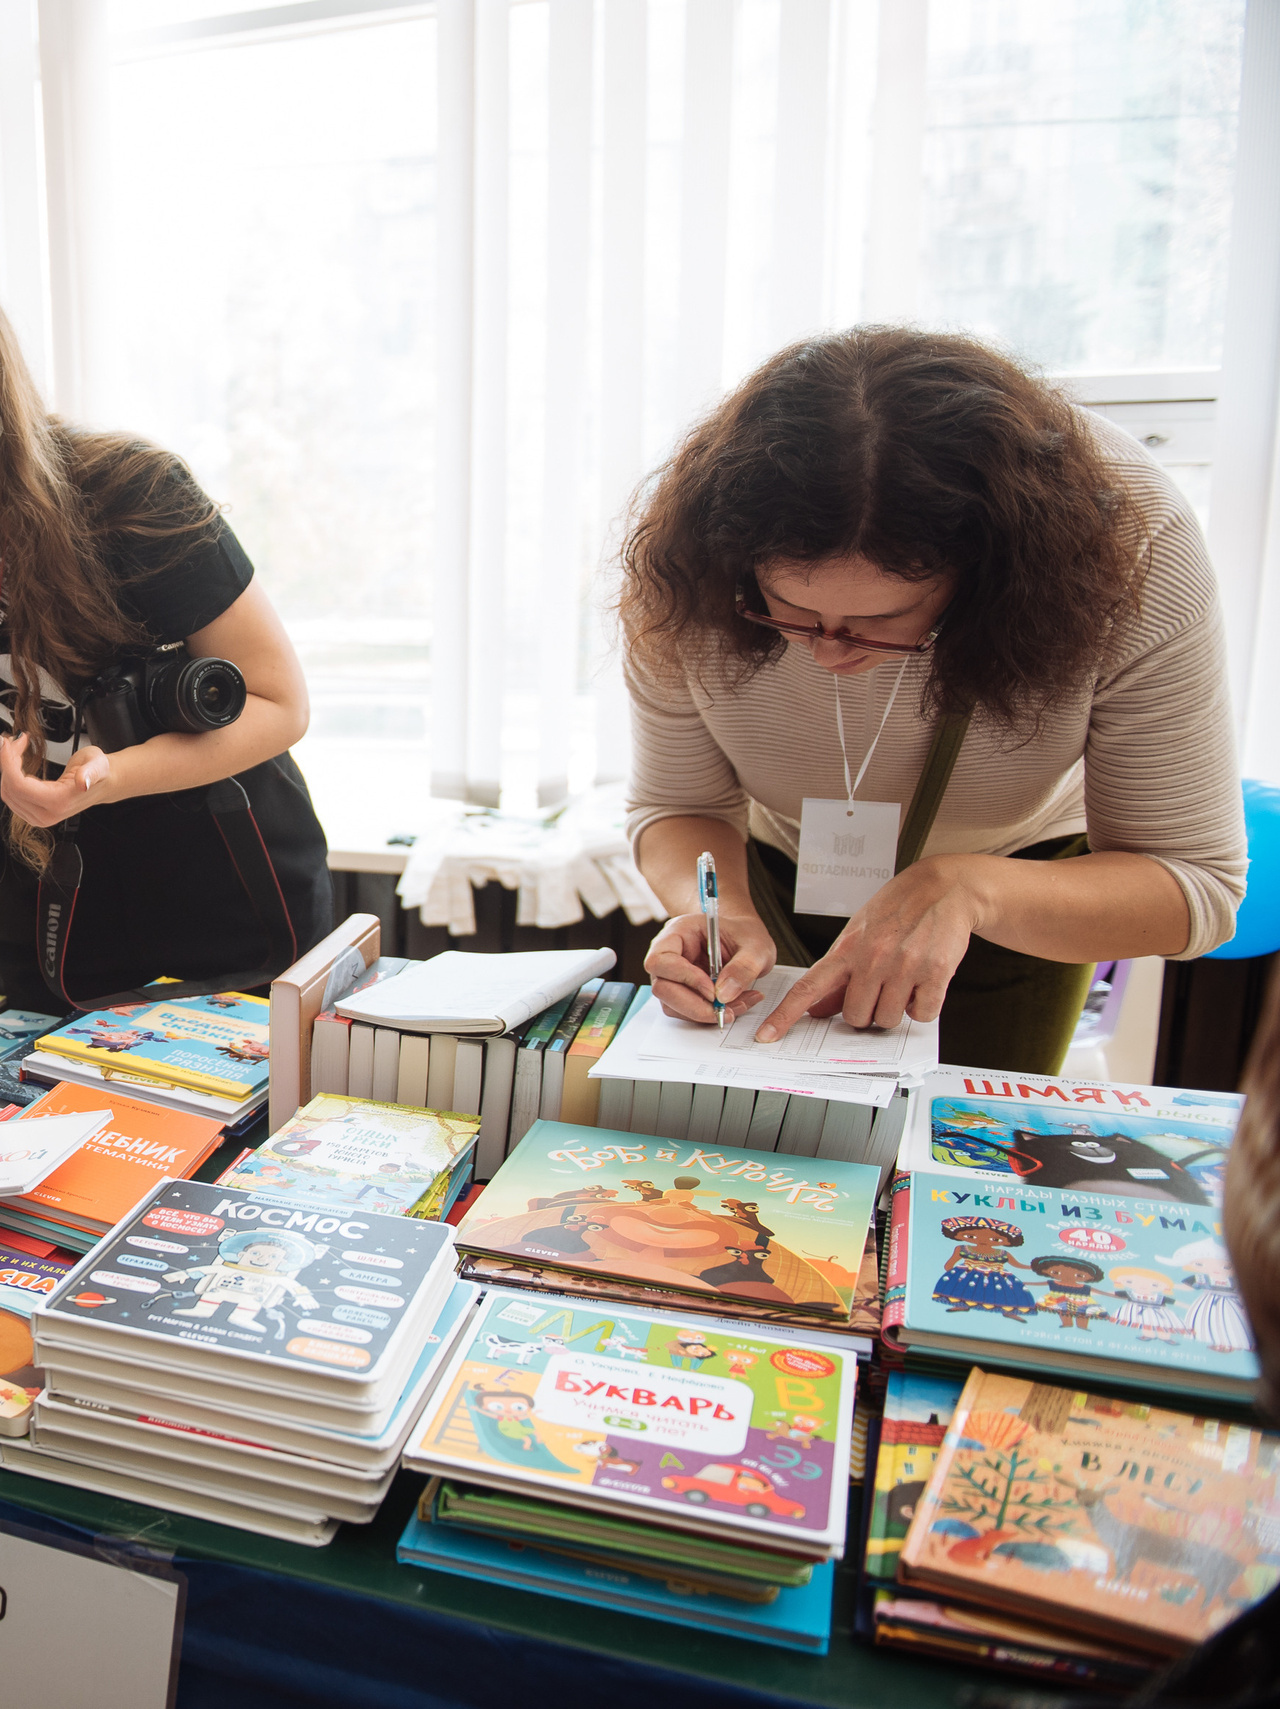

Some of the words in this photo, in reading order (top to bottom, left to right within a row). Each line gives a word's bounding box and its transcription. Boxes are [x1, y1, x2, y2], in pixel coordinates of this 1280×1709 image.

[161, 640, 185, 652] Canon
[44, 902, 62, 978] Canon
[162, 1054, 245, 1080] ГРЯЗНУЛЯ
[963, 1078, 1151, 1107] ШМЯК
[33, 1191, 62, 1202] CLEVER
[931, 1189, 1046, 1214] КУКЛЫ
[1061, 1204, 1103, 1220] ИЗ
[985, 1184, 1053, 1200] НАРЯДЫ
[1061, 1192, 1128, 1209] РАЗНЫХ
[1134, 1202, 1191, 1216] СТРАН
[147, 1213, 183, 1225] ХОТЕЛИ
[185, 1220, 220, 1231] УЗНАТЬ
[183, 1213, 201, 1221] ЧТО
[210, 1199, 370, 1240] КОСМОС
[160, 1221, 207, 1234] КОСМОСЕ!
[1069, 1229, 1113, 1245] 40
[524, 1246, 560, 1258] CLEVER
[1068, 1240, 1117, 1251] НАРЯДОВ
[22, 1260, 35, 1269] ИХ
[357, 1254, 387, 1265] ШЛЕМ
[349, 1272, 389, 1284] КАМЕРА
[554, 1370, 736, 1421] БУКВАРЬ
[1081, 1451, 1102, 1472] В
[1114, 1460, 1203, 1495] ЛЕСУ
